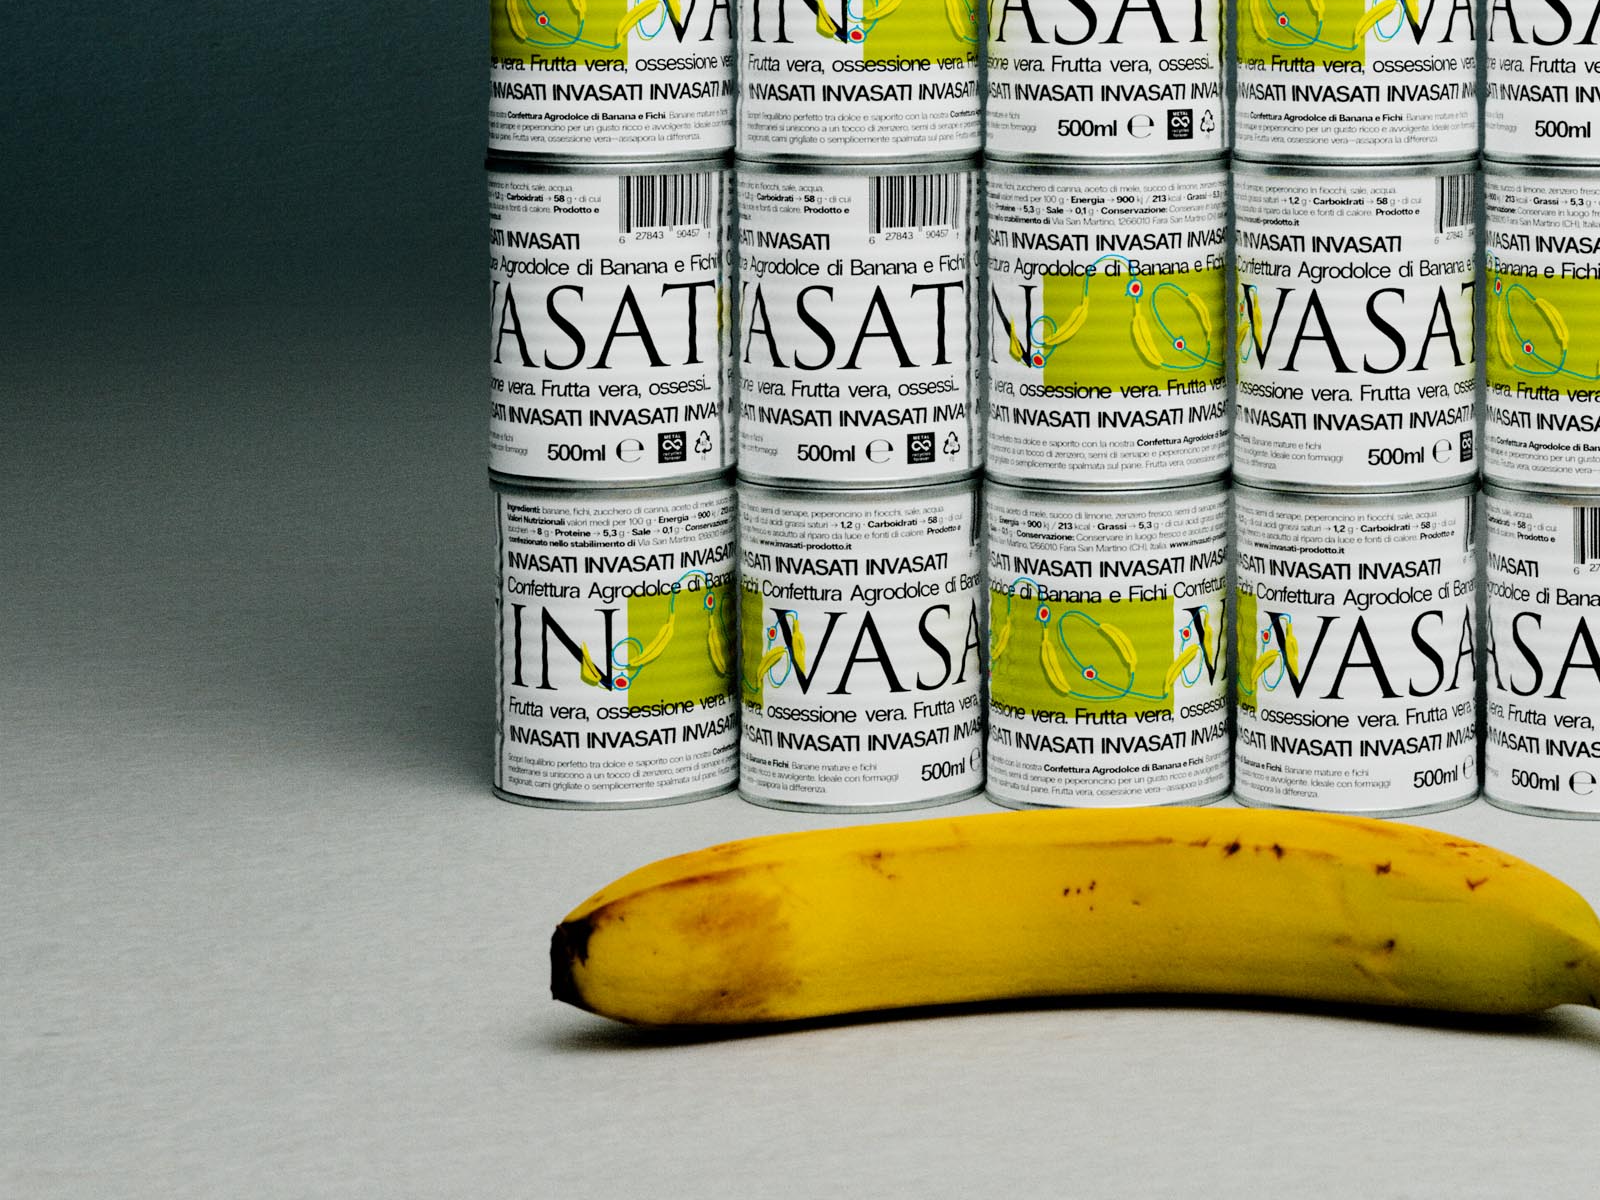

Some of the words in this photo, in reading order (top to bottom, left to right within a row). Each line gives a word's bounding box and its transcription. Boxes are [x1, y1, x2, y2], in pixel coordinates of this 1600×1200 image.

[1058, 120, 1117, 136] 500ml
[1535, 120, 1590, 138] 500ml
[507, 231, 579, 250] INVASATI
[1096, 233, 1181, 251] INVASATI
[1312, 236, 1401, 253] INVASATI
[851, 259, 917, 275] Banana
[1014, 258, 1096, 280] Agrodolce
[1561, 262, 1600, 280] Fichi
[840, 408, 927, 427] INVASATI
[548, 444, 605, 461] 500ml
[798, 444, 855, 461] 500ml
[1368, 447, 1424, 465] 500ml
[585, 553, 674, 573] INVASATI
[776, 556, 858, 575] INVASATI
[1100, 557, 1184, 577] INVASATI
[1359, 558, 1440, 579] INVASATI
[588, 580, 681, 604] Agrodolce
[1038, 585, 1101, 607] Banana
[922, 758, 965, 781] 500ml
[1414, 765, 1457, 788] 500ml
[1512, 769, 1559, 791] 500ml
